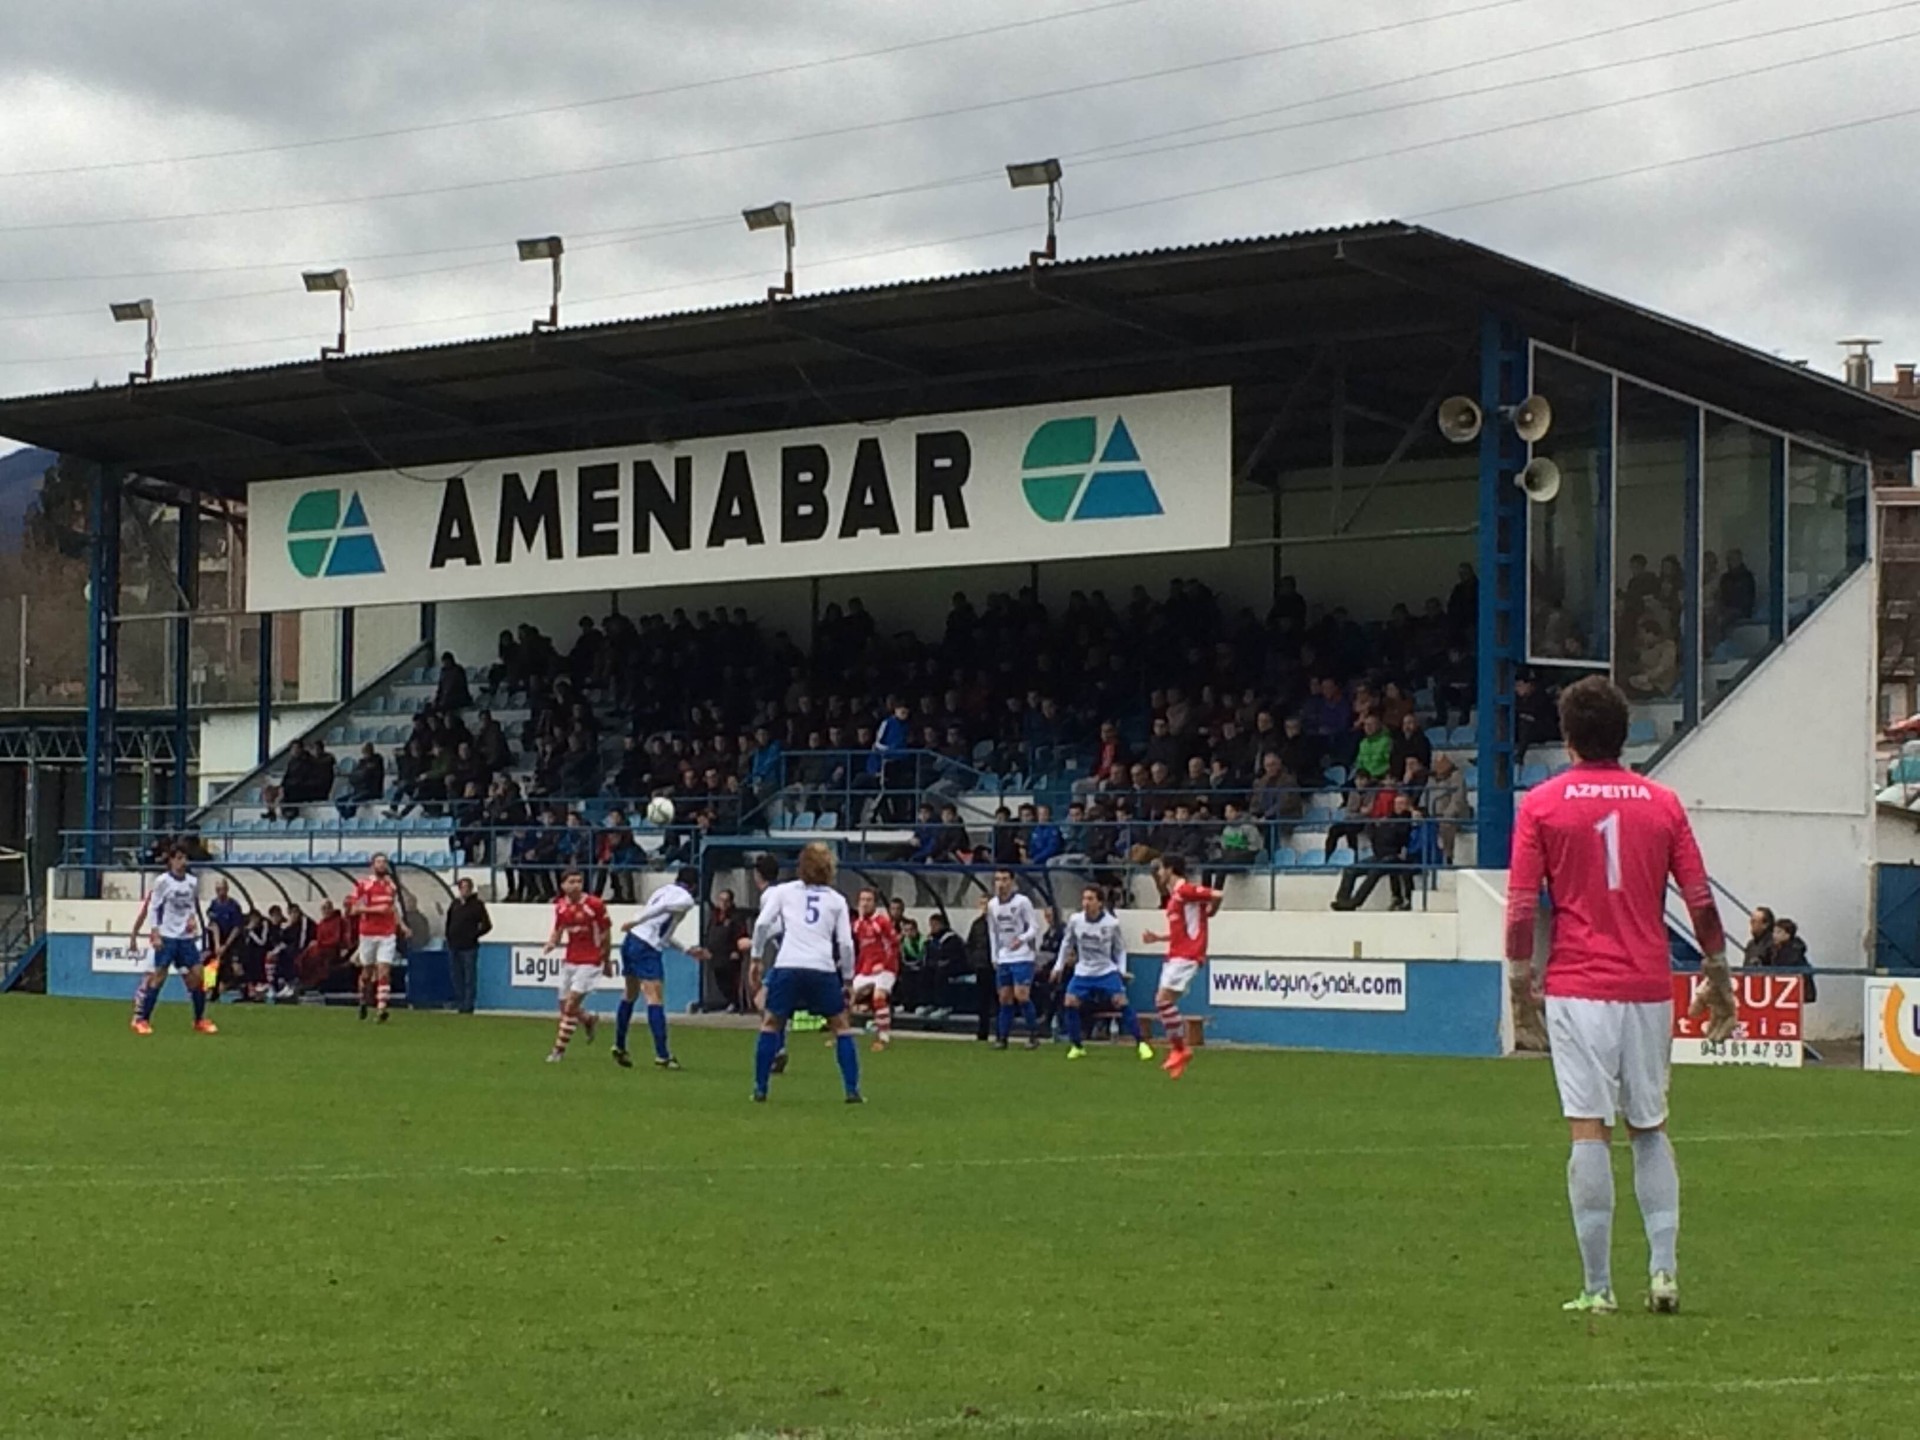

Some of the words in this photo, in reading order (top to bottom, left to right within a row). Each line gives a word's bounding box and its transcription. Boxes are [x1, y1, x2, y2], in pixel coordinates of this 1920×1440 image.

[430, 429, 972, 569] AMENABAR
[1563, 783, 1652, 800] AZPEITIA
[1593, 810, 1621, 892] 1
[804, 895, 820, 925] 5
[1700, 1041, 1727, 1057] 943
[1752, 1043, 1770, 1058] 47
[1775, 1043, 1793, 1059] 93
